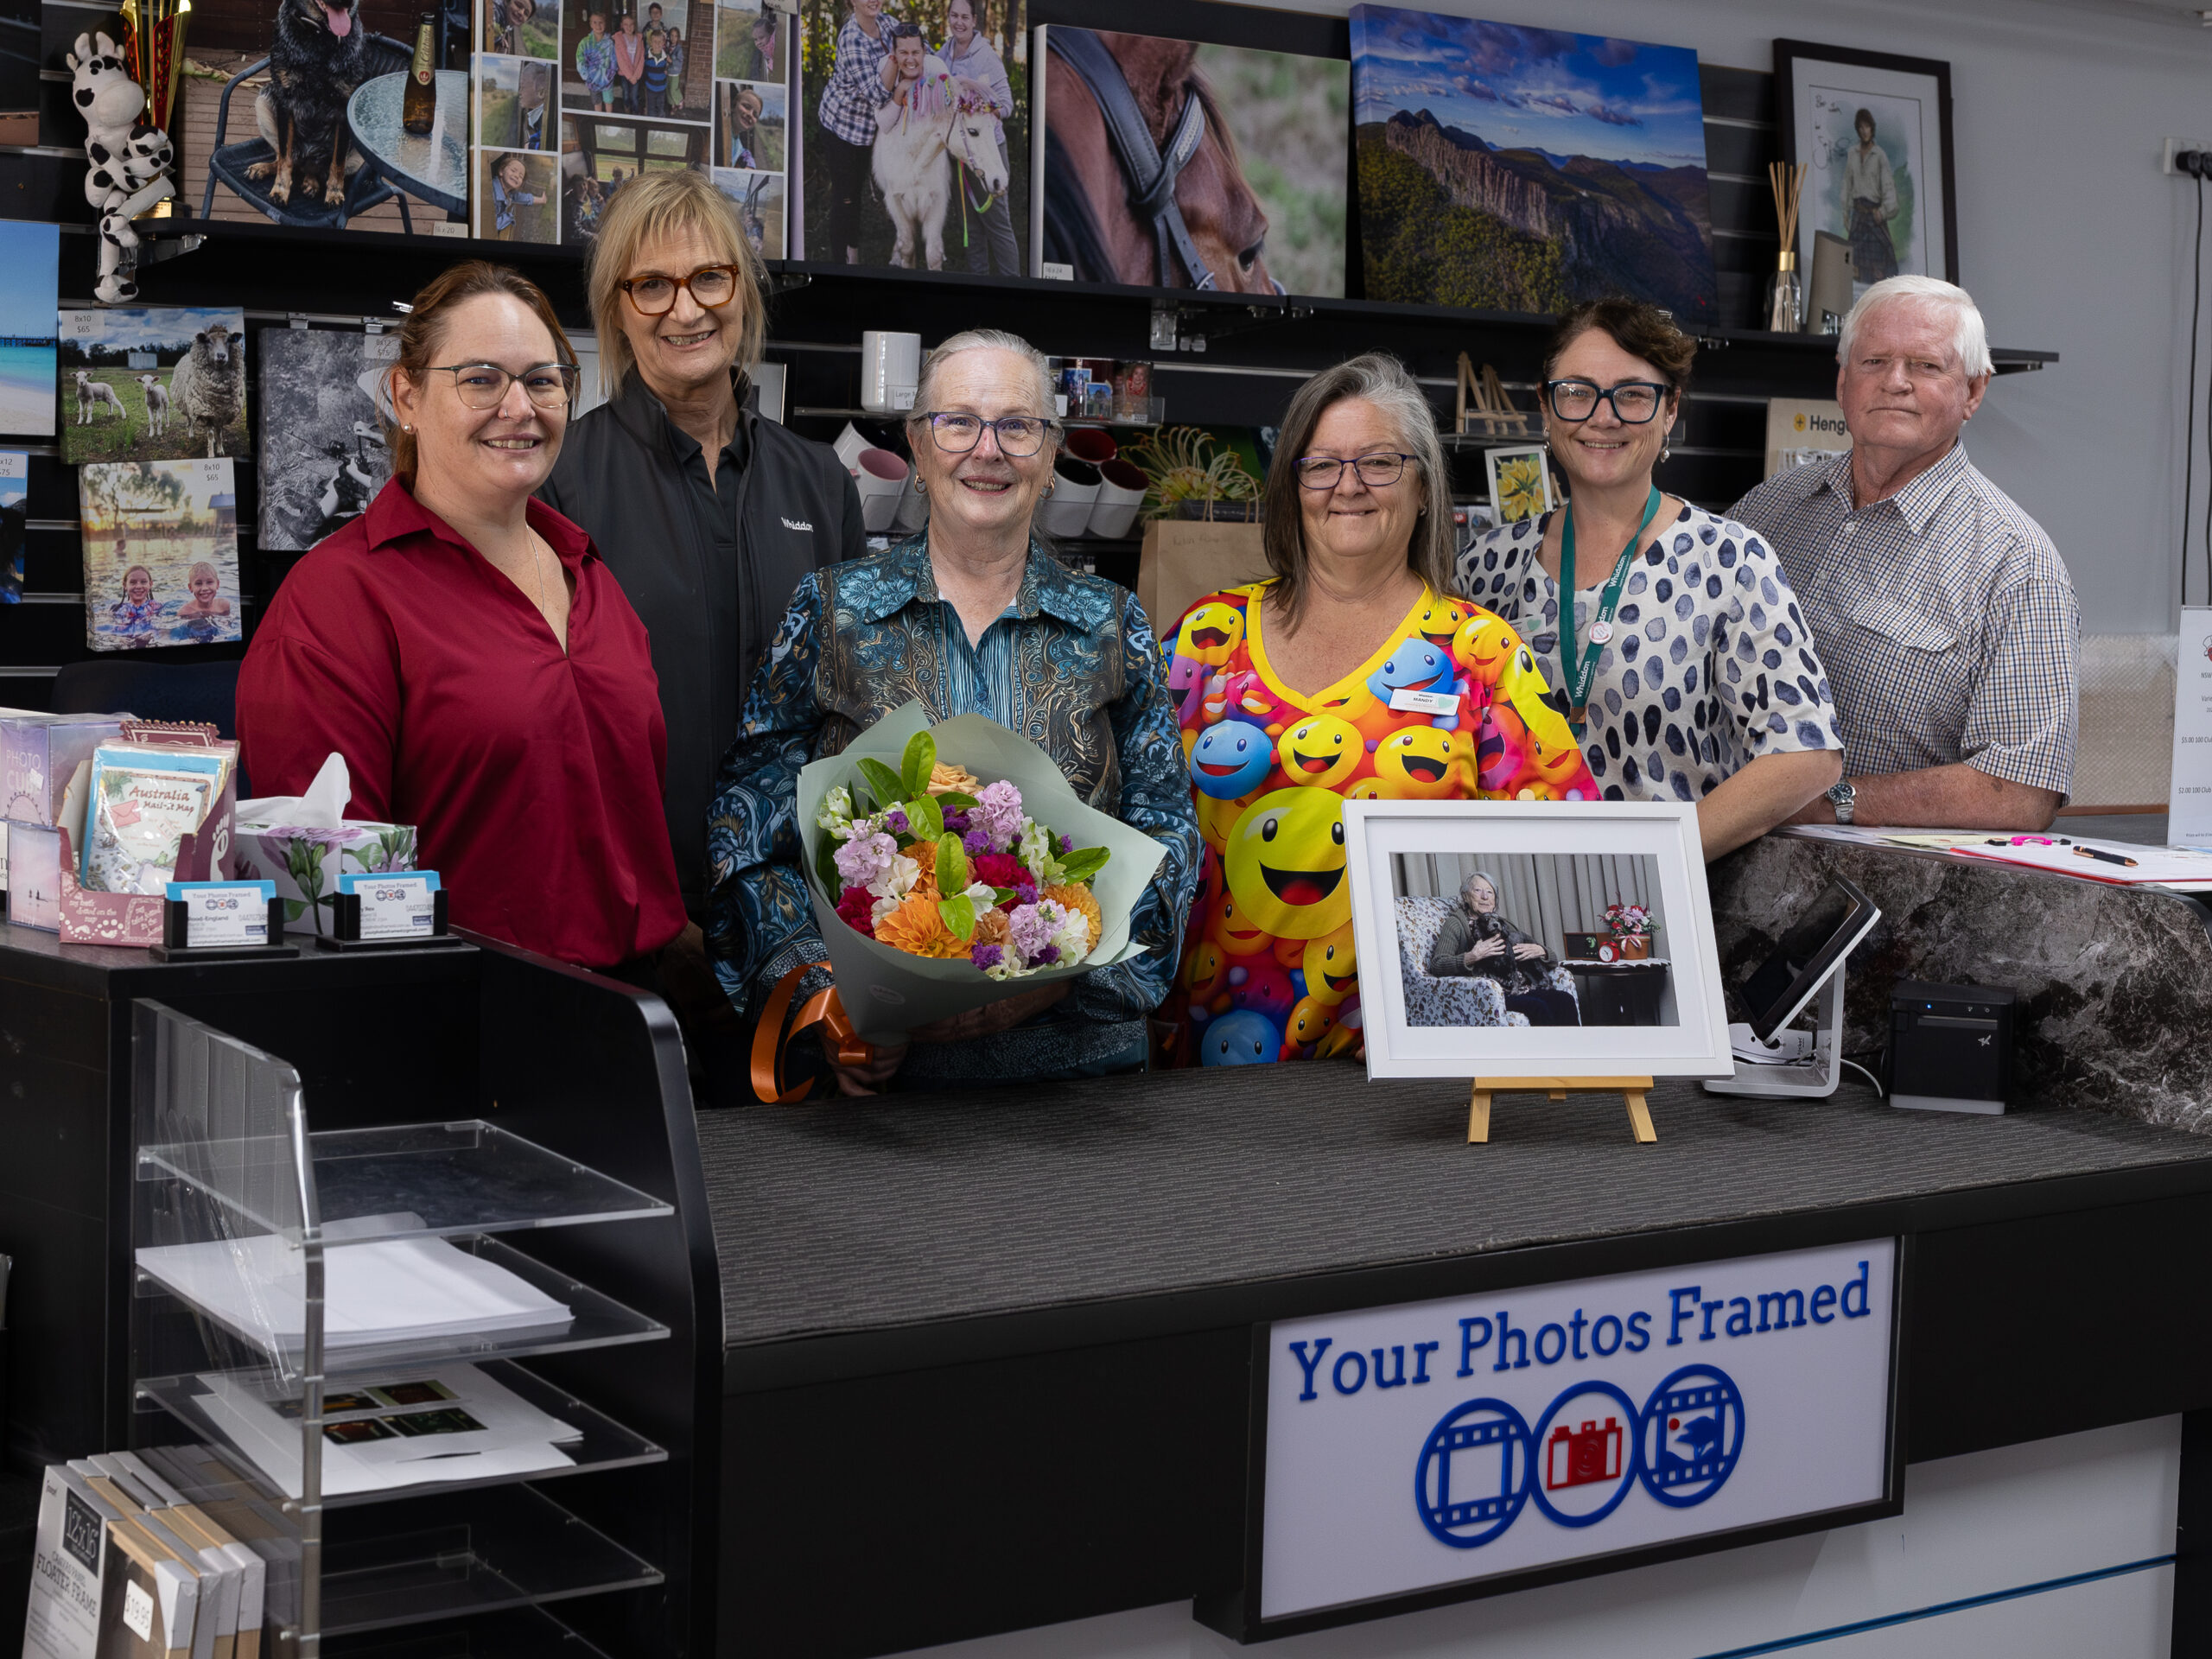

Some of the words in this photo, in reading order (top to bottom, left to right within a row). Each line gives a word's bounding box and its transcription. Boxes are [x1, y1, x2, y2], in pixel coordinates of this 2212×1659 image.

[1608, 554, 1627, 588] Whiddon
[1574, 660, 1591, 698] Whiddon
[7, 749, 41, 770] PHOTO
[129, 785, 190, 802] Australia
[1288, 1338, 1440, 1403] Your
[1456, 1308, 1653, 1378] Photos
[1666, 1260, 1872, 1347] Framed
[36, 1553, 70, 1593] FLOATER
[71, 1580, 97, 1618] FRAME
